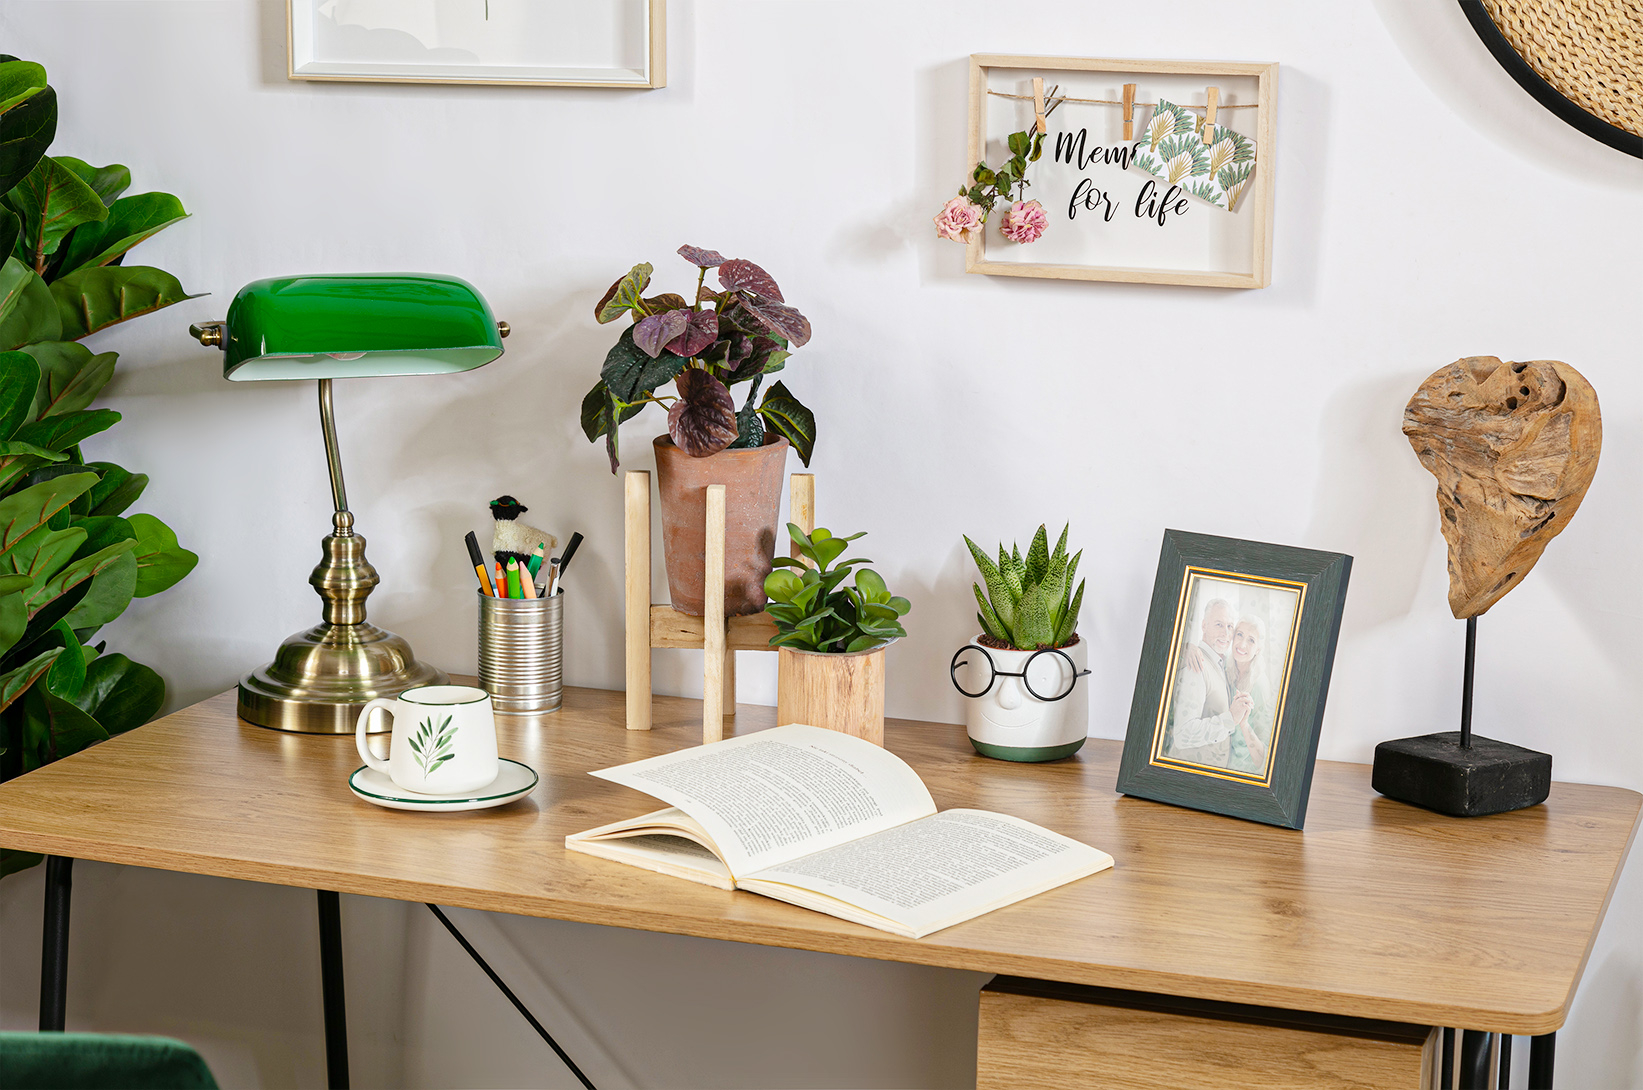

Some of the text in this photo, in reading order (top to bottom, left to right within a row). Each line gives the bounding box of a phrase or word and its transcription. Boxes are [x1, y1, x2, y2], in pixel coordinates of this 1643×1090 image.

[1055, 128, 1141, 170] Mem
[1068, 178, 1189, 227] for life
